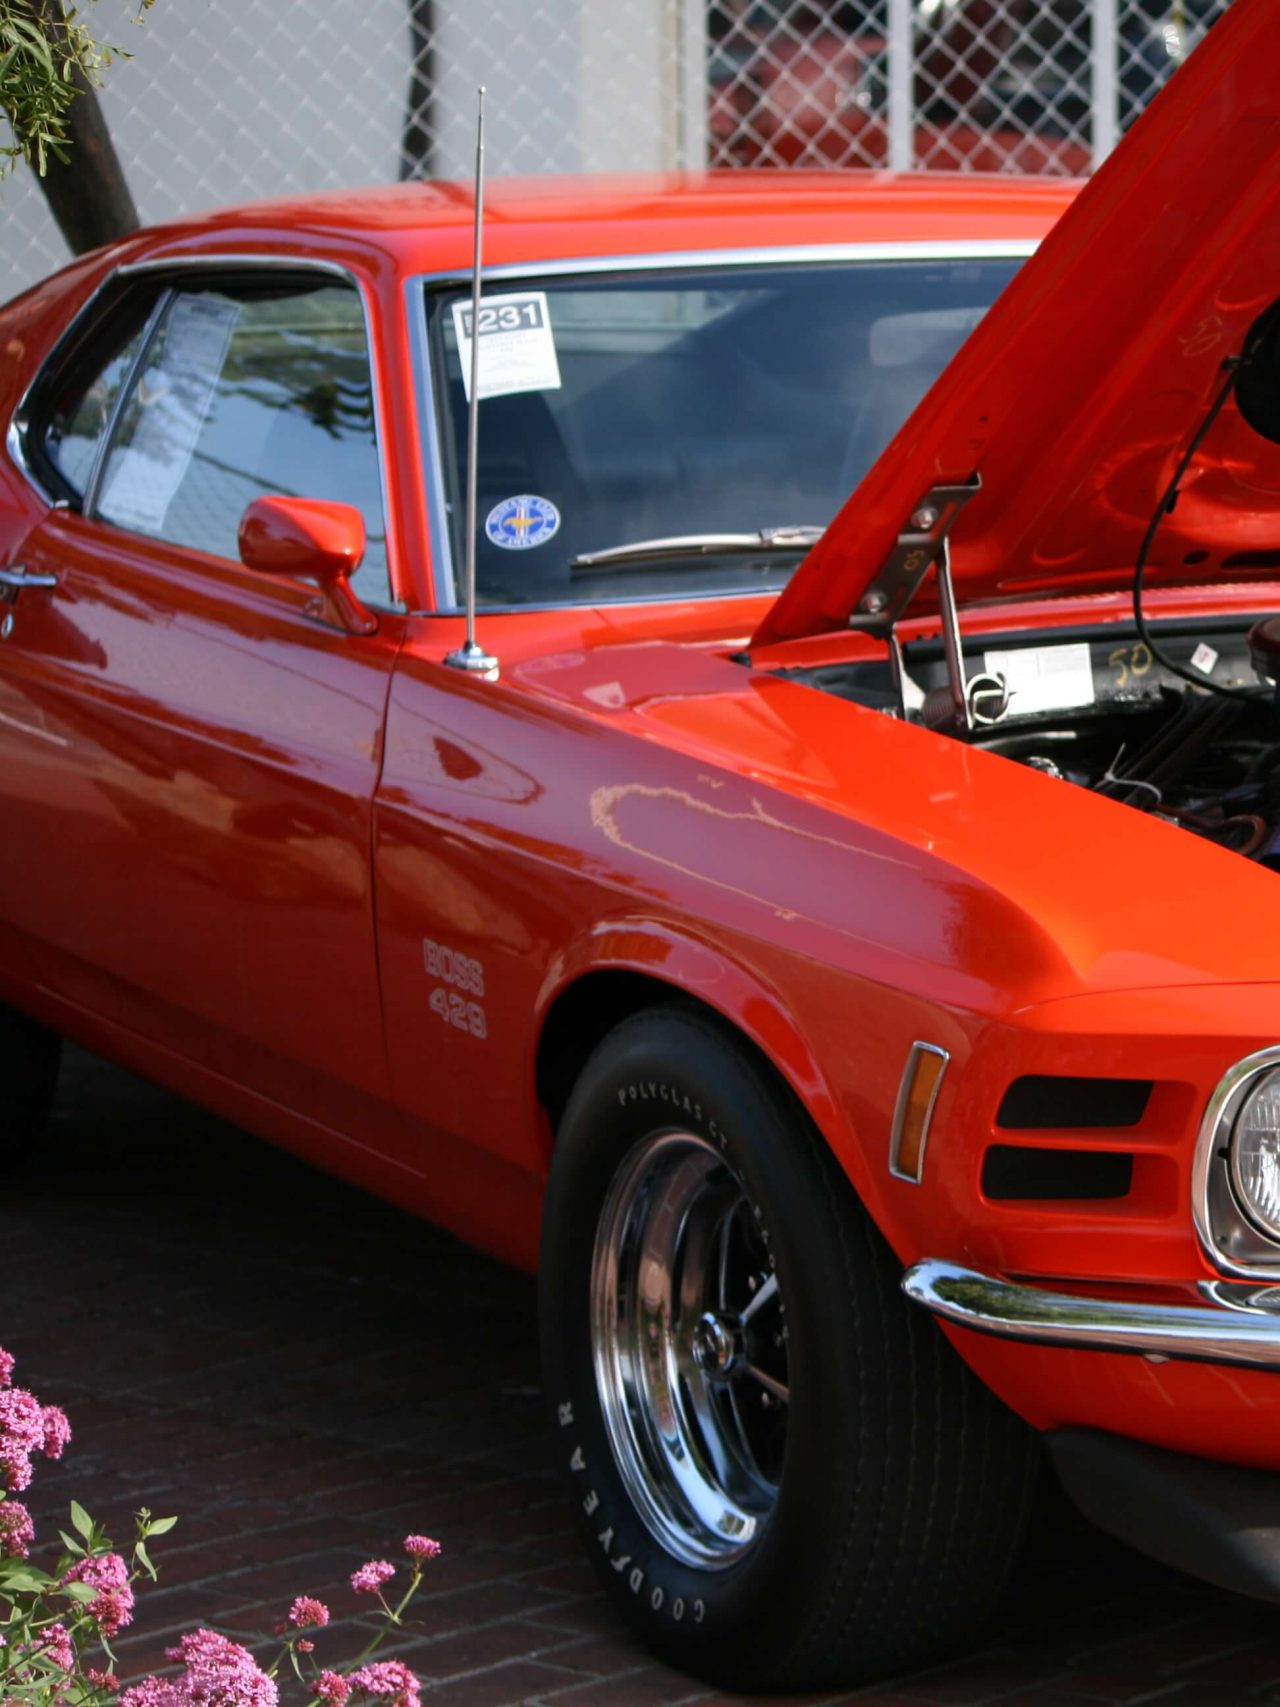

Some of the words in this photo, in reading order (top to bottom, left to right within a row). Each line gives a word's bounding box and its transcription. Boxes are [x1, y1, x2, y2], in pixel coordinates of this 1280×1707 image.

[478, 303, 538, 333] 231
[1109, 643, 1152, 686] 50
[423, 937, 485, 997] BOSS
[428, 988, 488, 1040] 429
